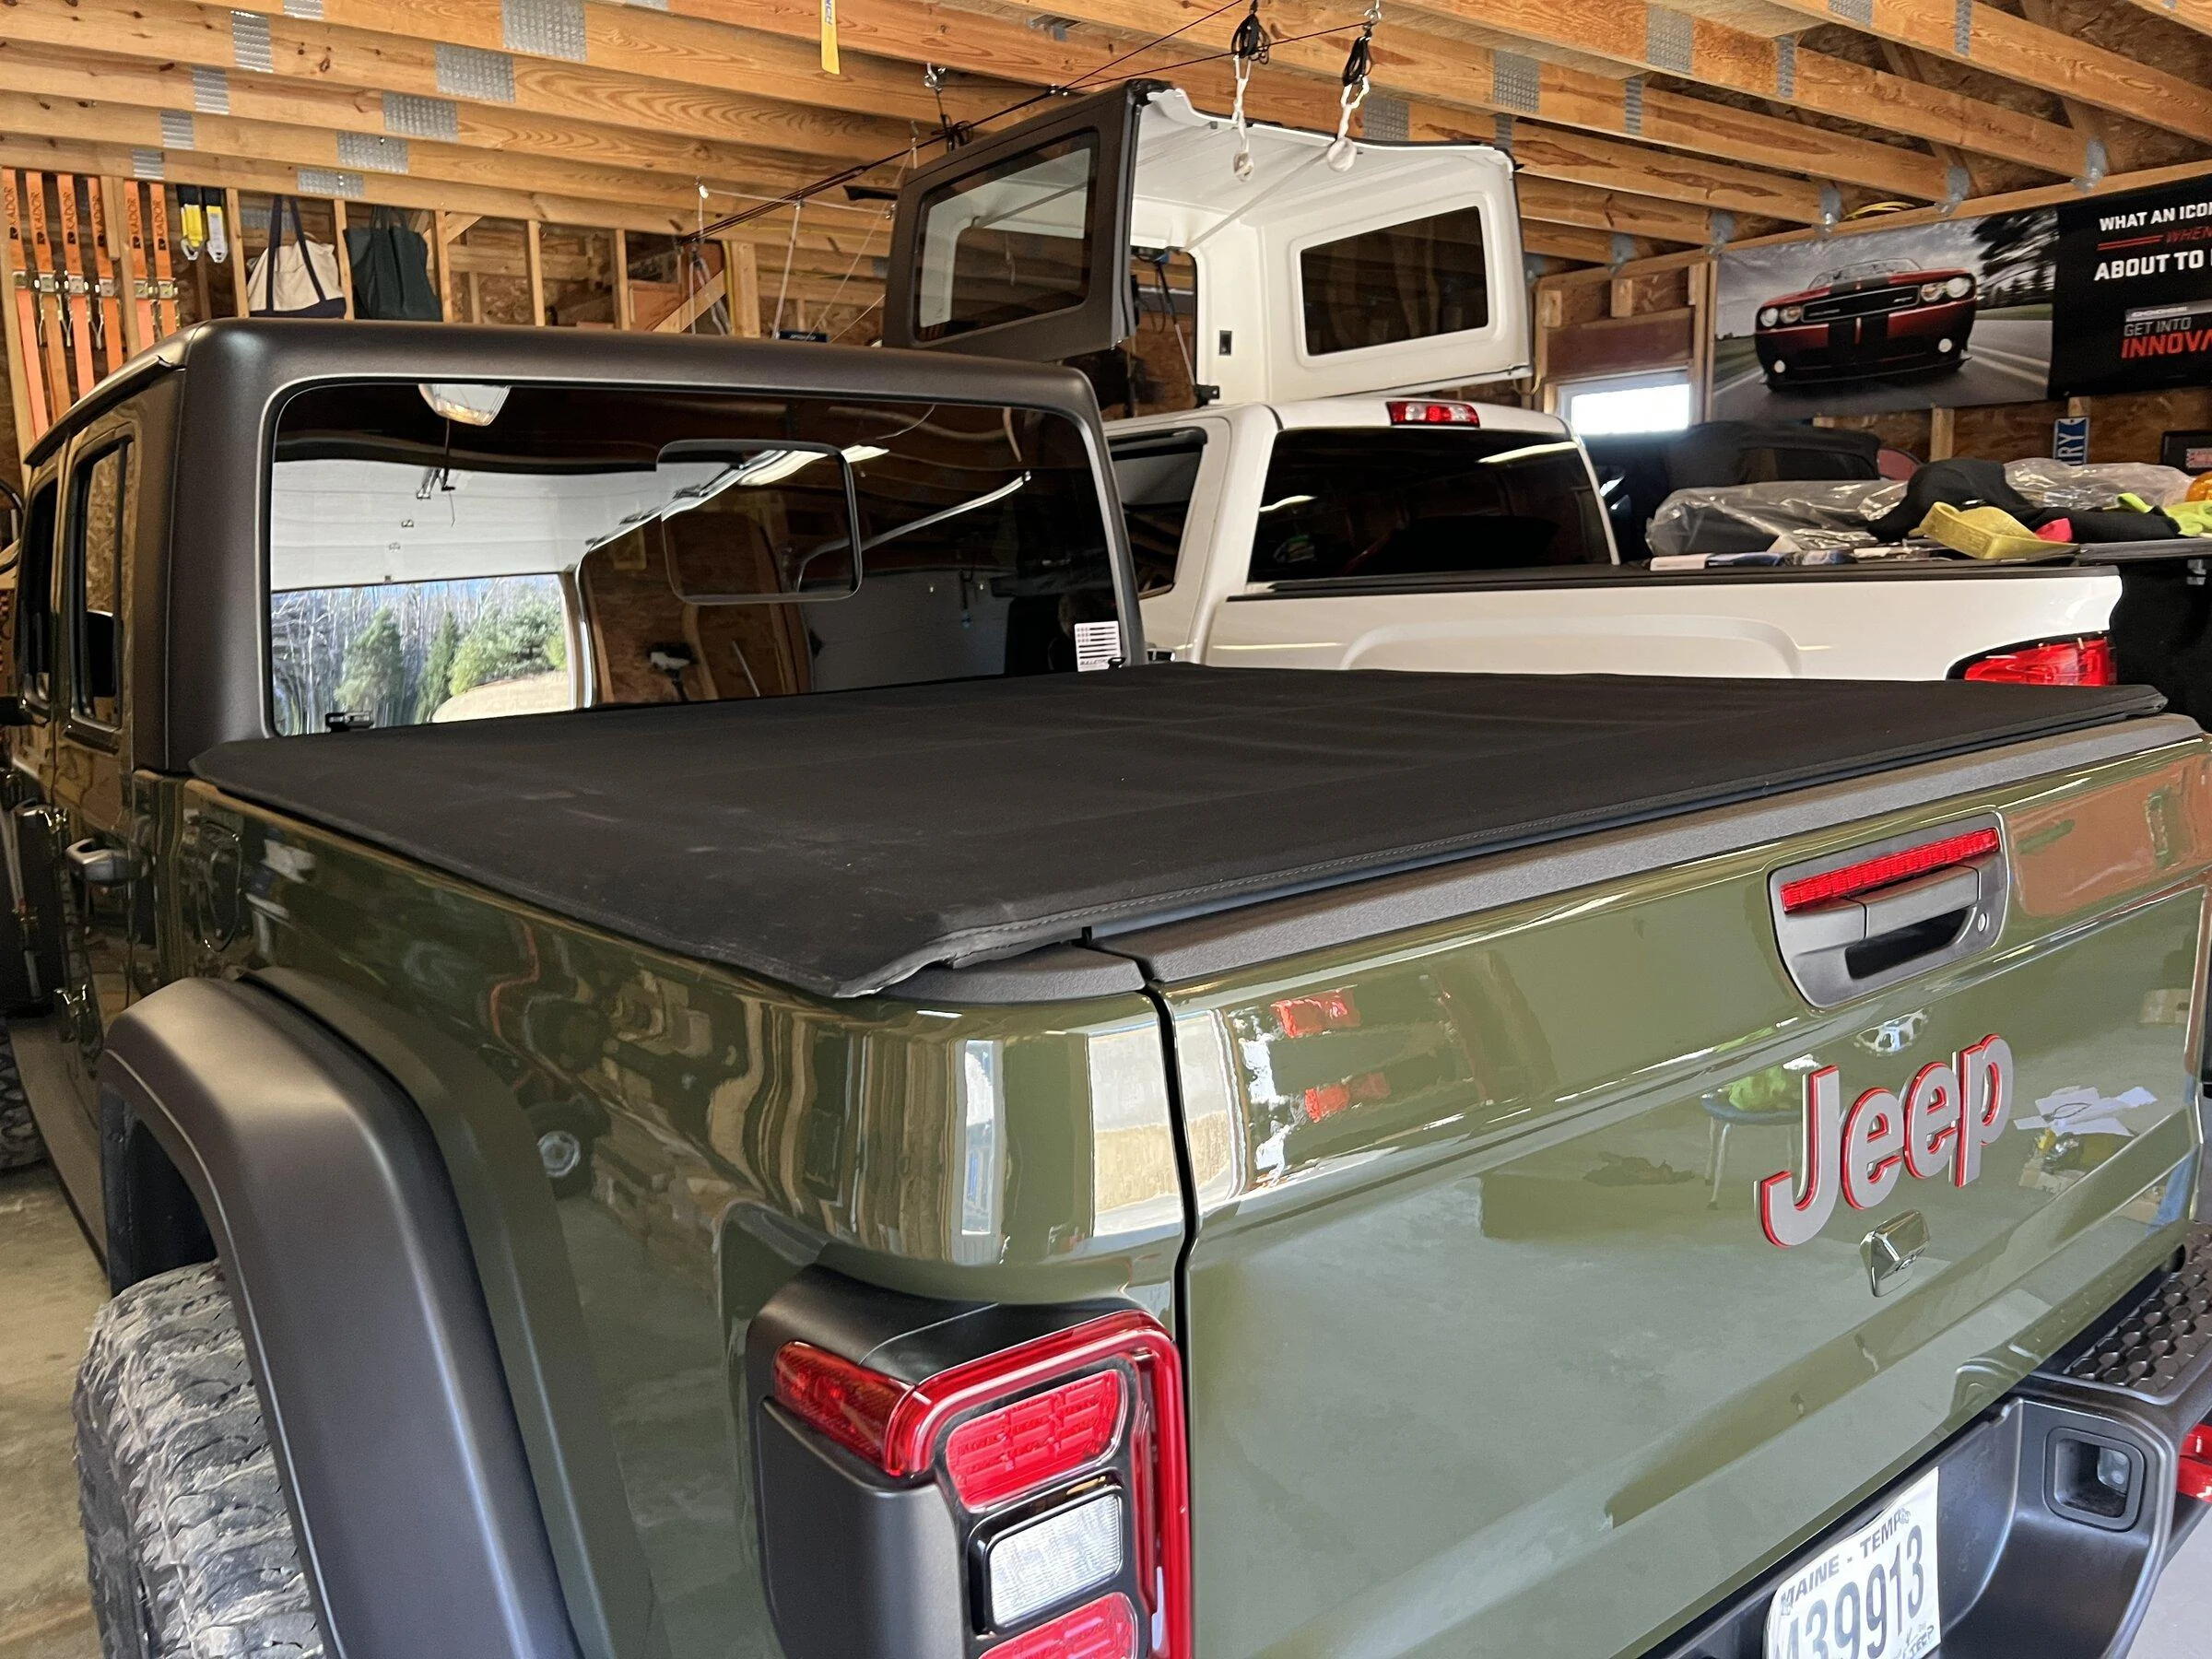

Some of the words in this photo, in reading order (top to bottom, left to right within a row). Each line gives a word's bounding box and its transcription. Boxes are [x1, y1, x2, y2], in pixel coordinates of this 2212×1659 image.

[2099, 211, 2148, 231] WHAT
[2150, 207, 2175, 224] AN
[2179, 201, 2212, 220] ICO
[2093, 253, 2171, 281] ABOUT
[2173, 249, 2204, 271] TO
[2124, 321, 2154, 337] GET
[2156, 316, 2192, 334] INTO
[1759, 1033, 2014, 1248] Jeep
[1781, 1553, 1840, 1610] MAINE
